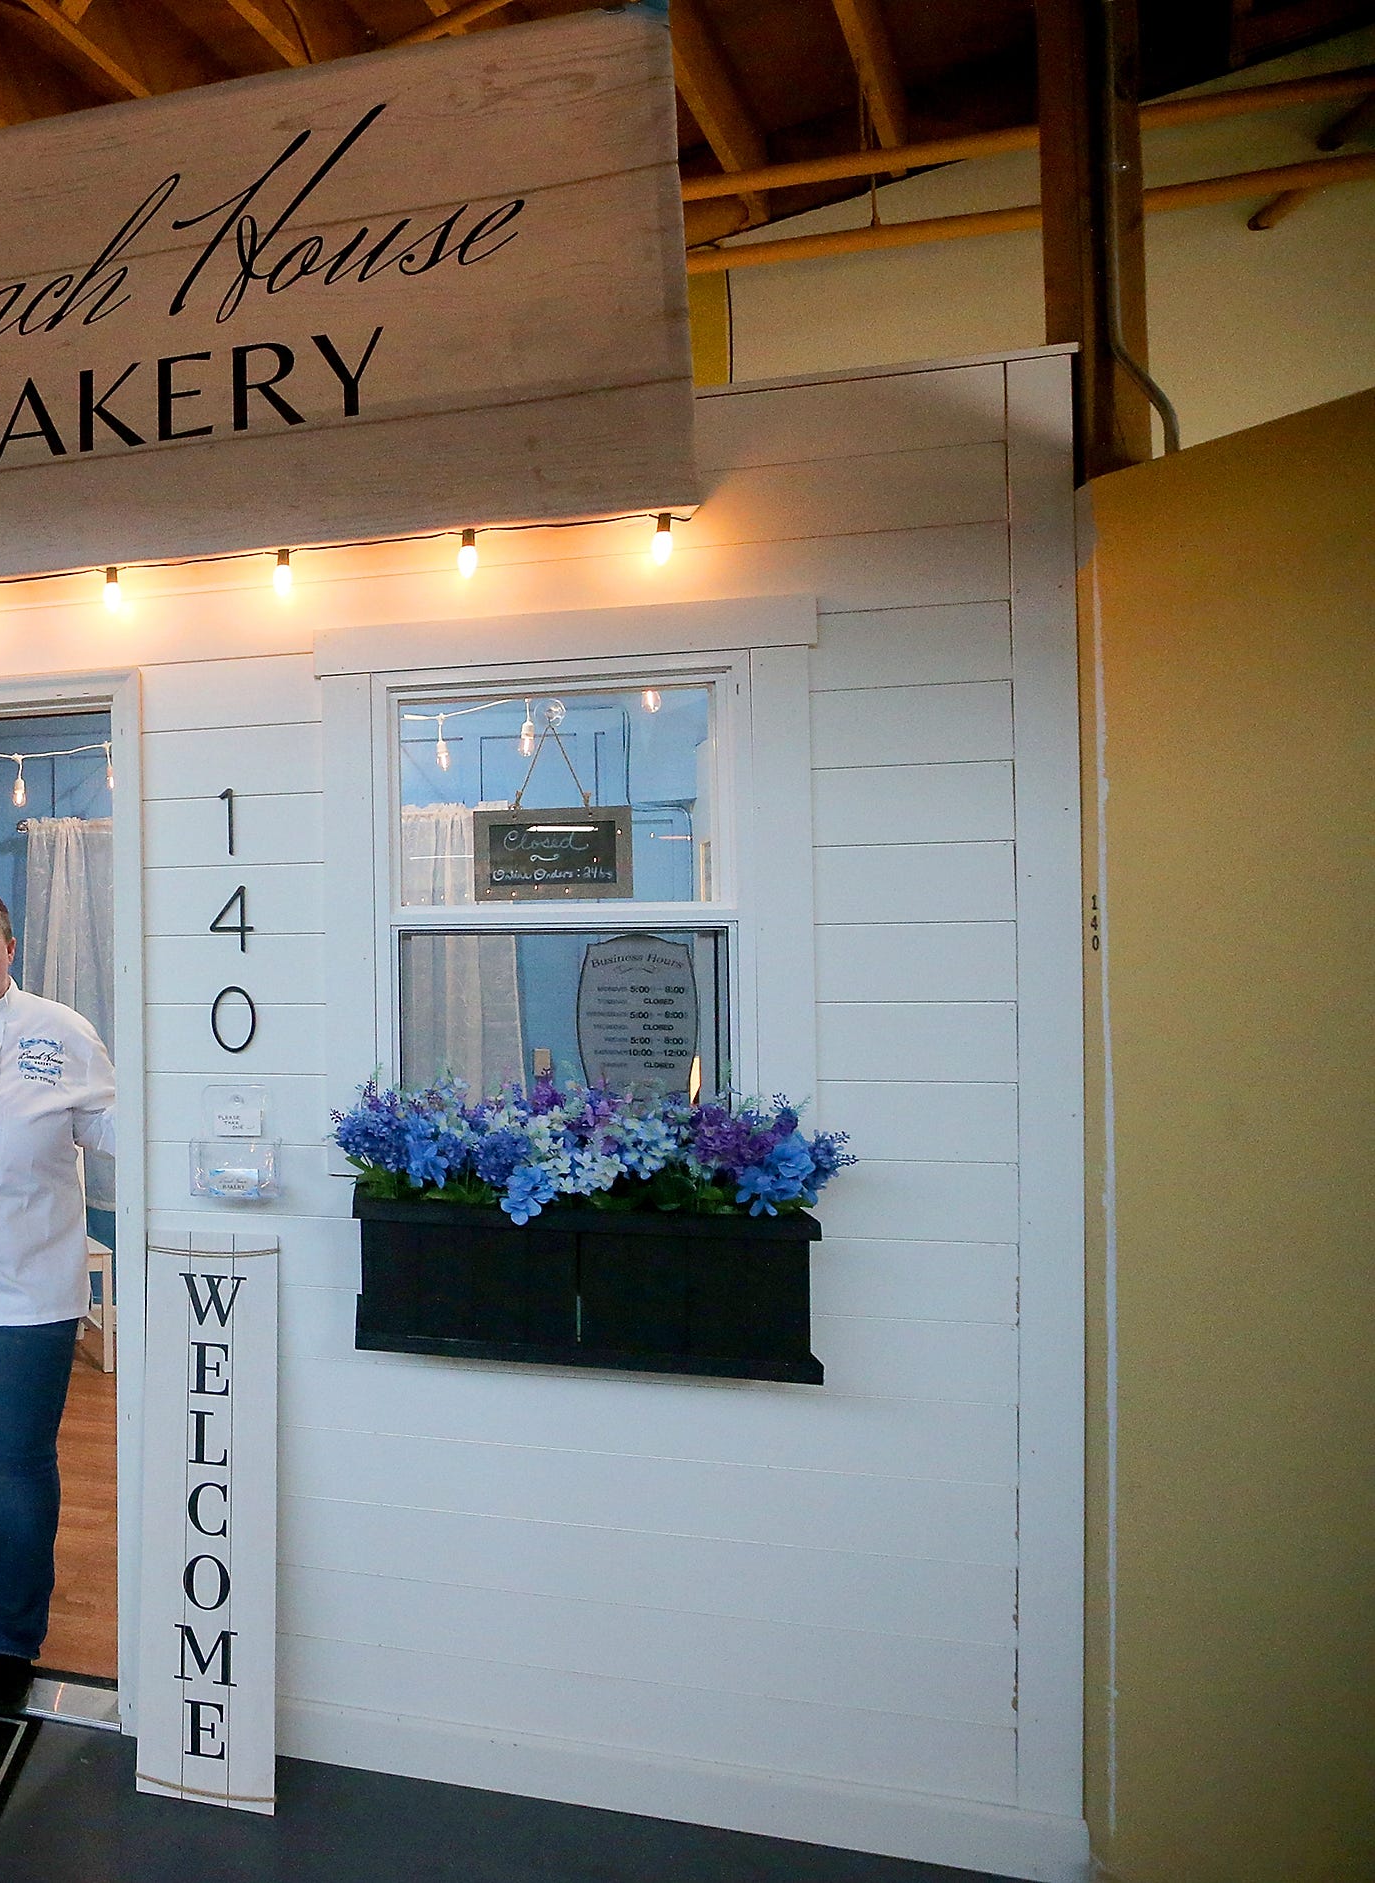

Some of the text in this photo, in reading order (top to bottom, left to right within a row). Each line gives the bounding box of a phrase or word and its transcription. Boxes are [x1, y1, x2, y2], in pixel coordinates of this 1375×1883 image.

[169, 103, 524, 324] House
[504, 829, 588, 850] Closed
[1091, 895, 1099, 950] 140
[173, 1272, 247, 1762] WELCOME
